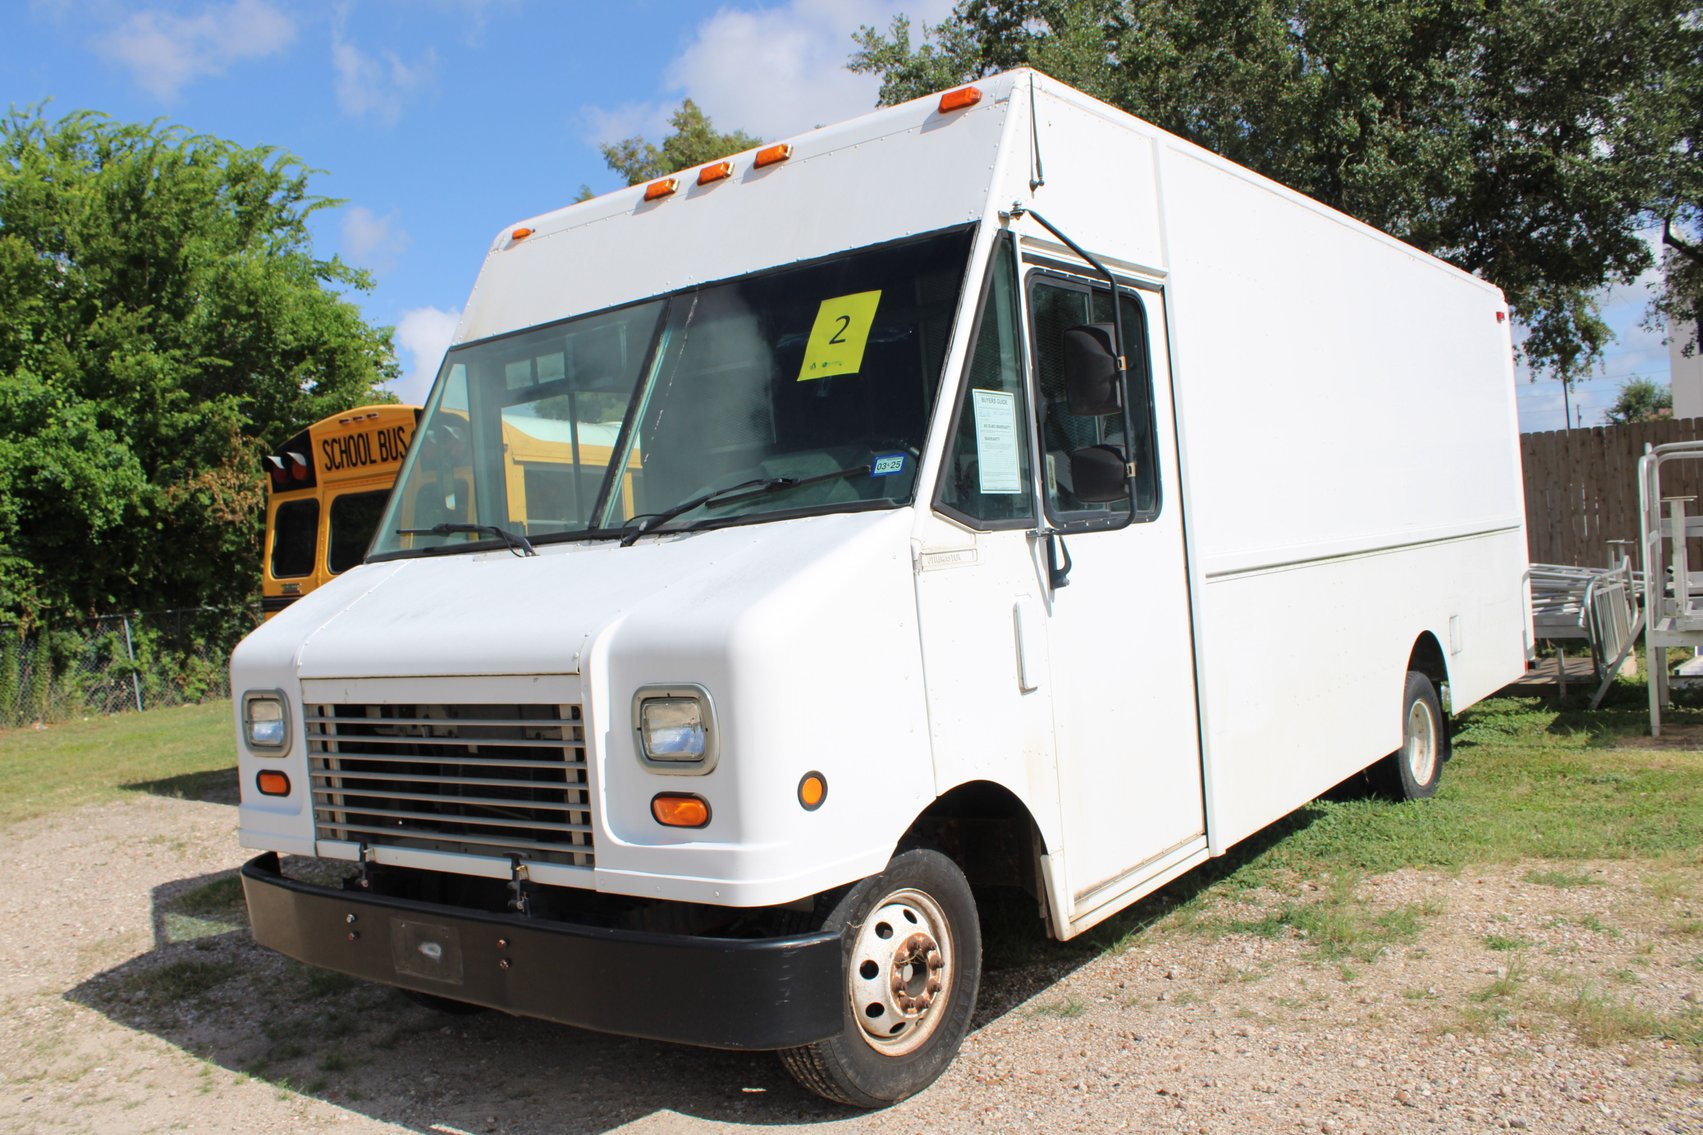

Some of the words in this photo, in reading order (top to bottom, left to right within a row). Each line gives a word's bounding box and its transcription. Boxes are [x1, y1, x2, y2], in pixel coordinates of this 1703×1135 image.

[829, 315, 850, 345] 2
[322, 432, 376, 471] SCHOOL
[377, 426, 408, 462] BUS
